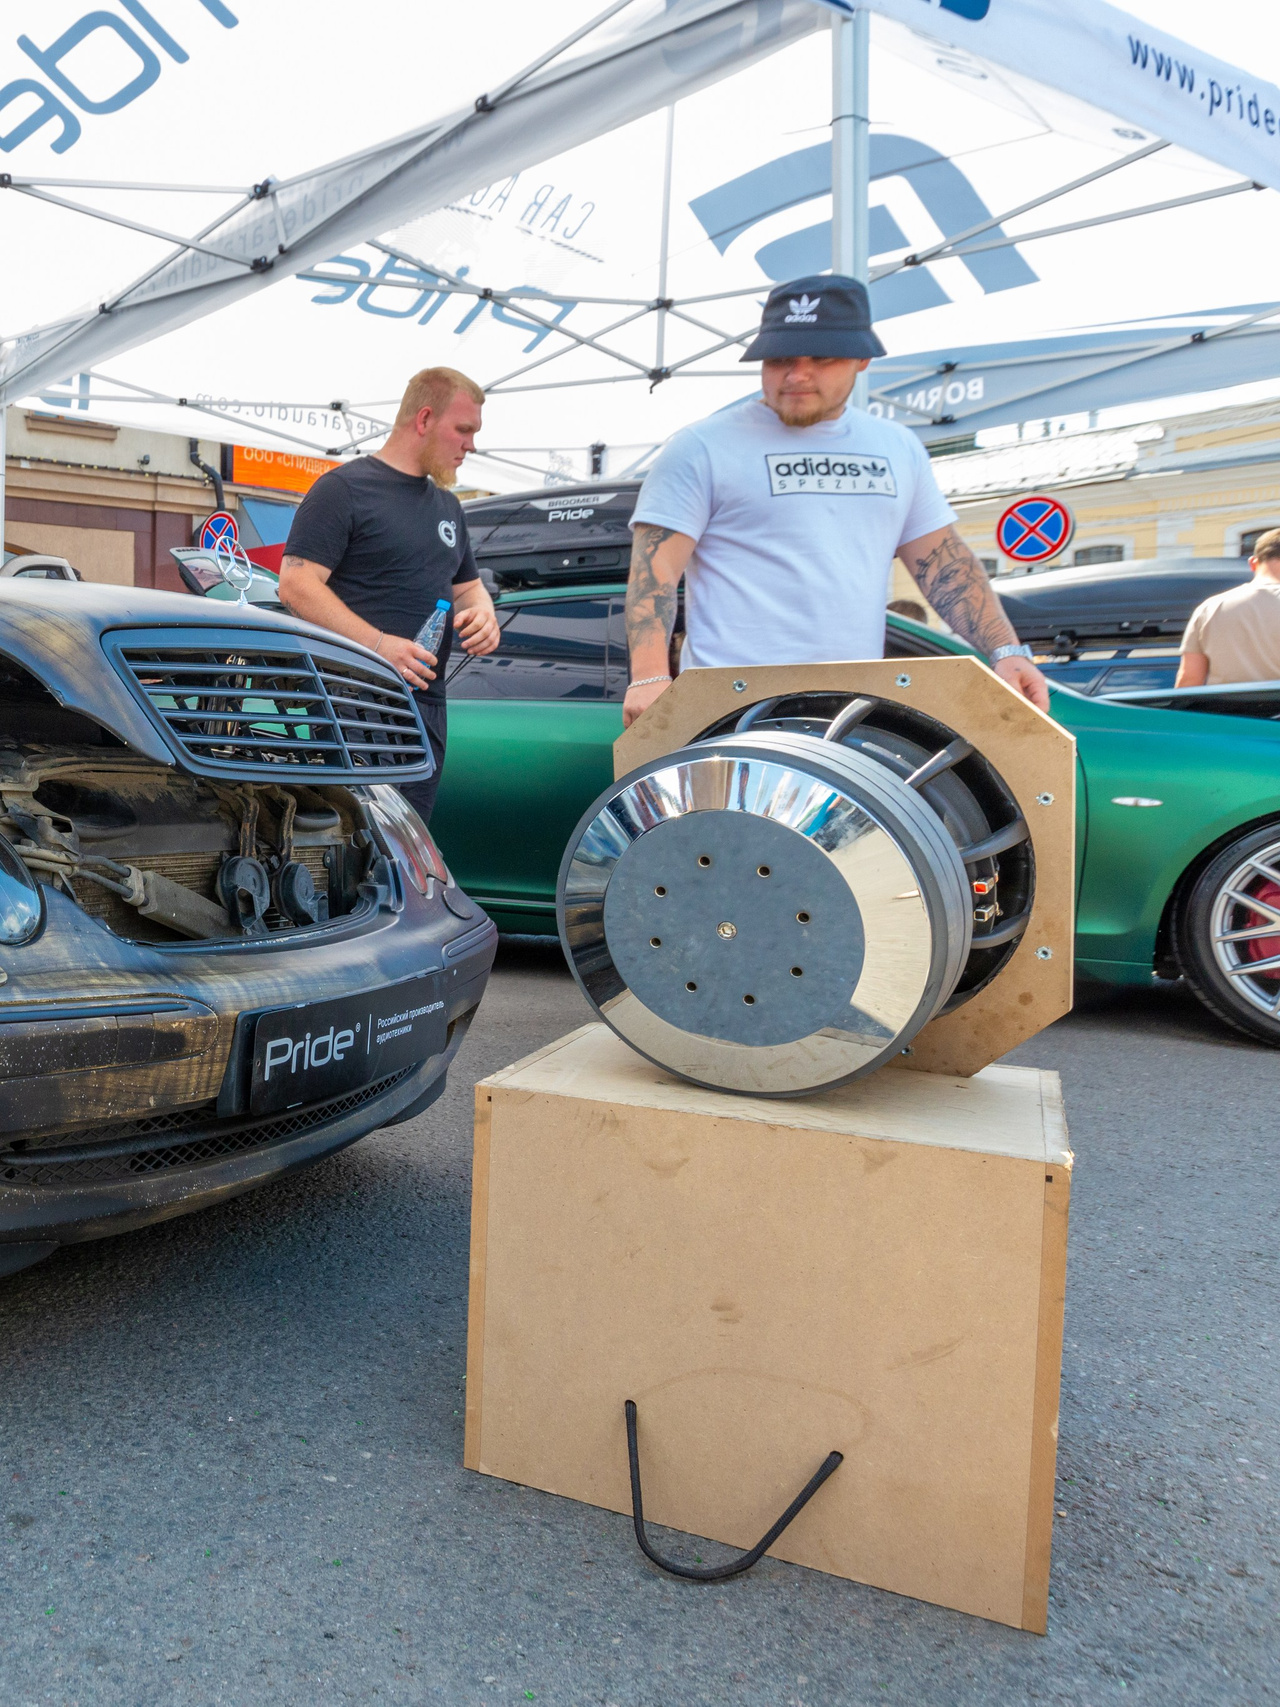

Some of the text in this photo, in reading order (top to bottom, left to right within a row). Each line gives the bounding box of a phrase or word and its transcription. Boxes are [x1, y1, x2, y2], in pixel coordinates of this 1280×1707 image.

[1127, 33, 1280, 133] www.pride
[784, 312, 818, 323] adidas
[775, 457, 861, 478] adidas
[778, 478, 892, 492] SPEZIAL
[548, 496, 600, 507] BROOMER
[548, 508, 594, 523] Pride
[377, 1009, 409, 1029] Российский
